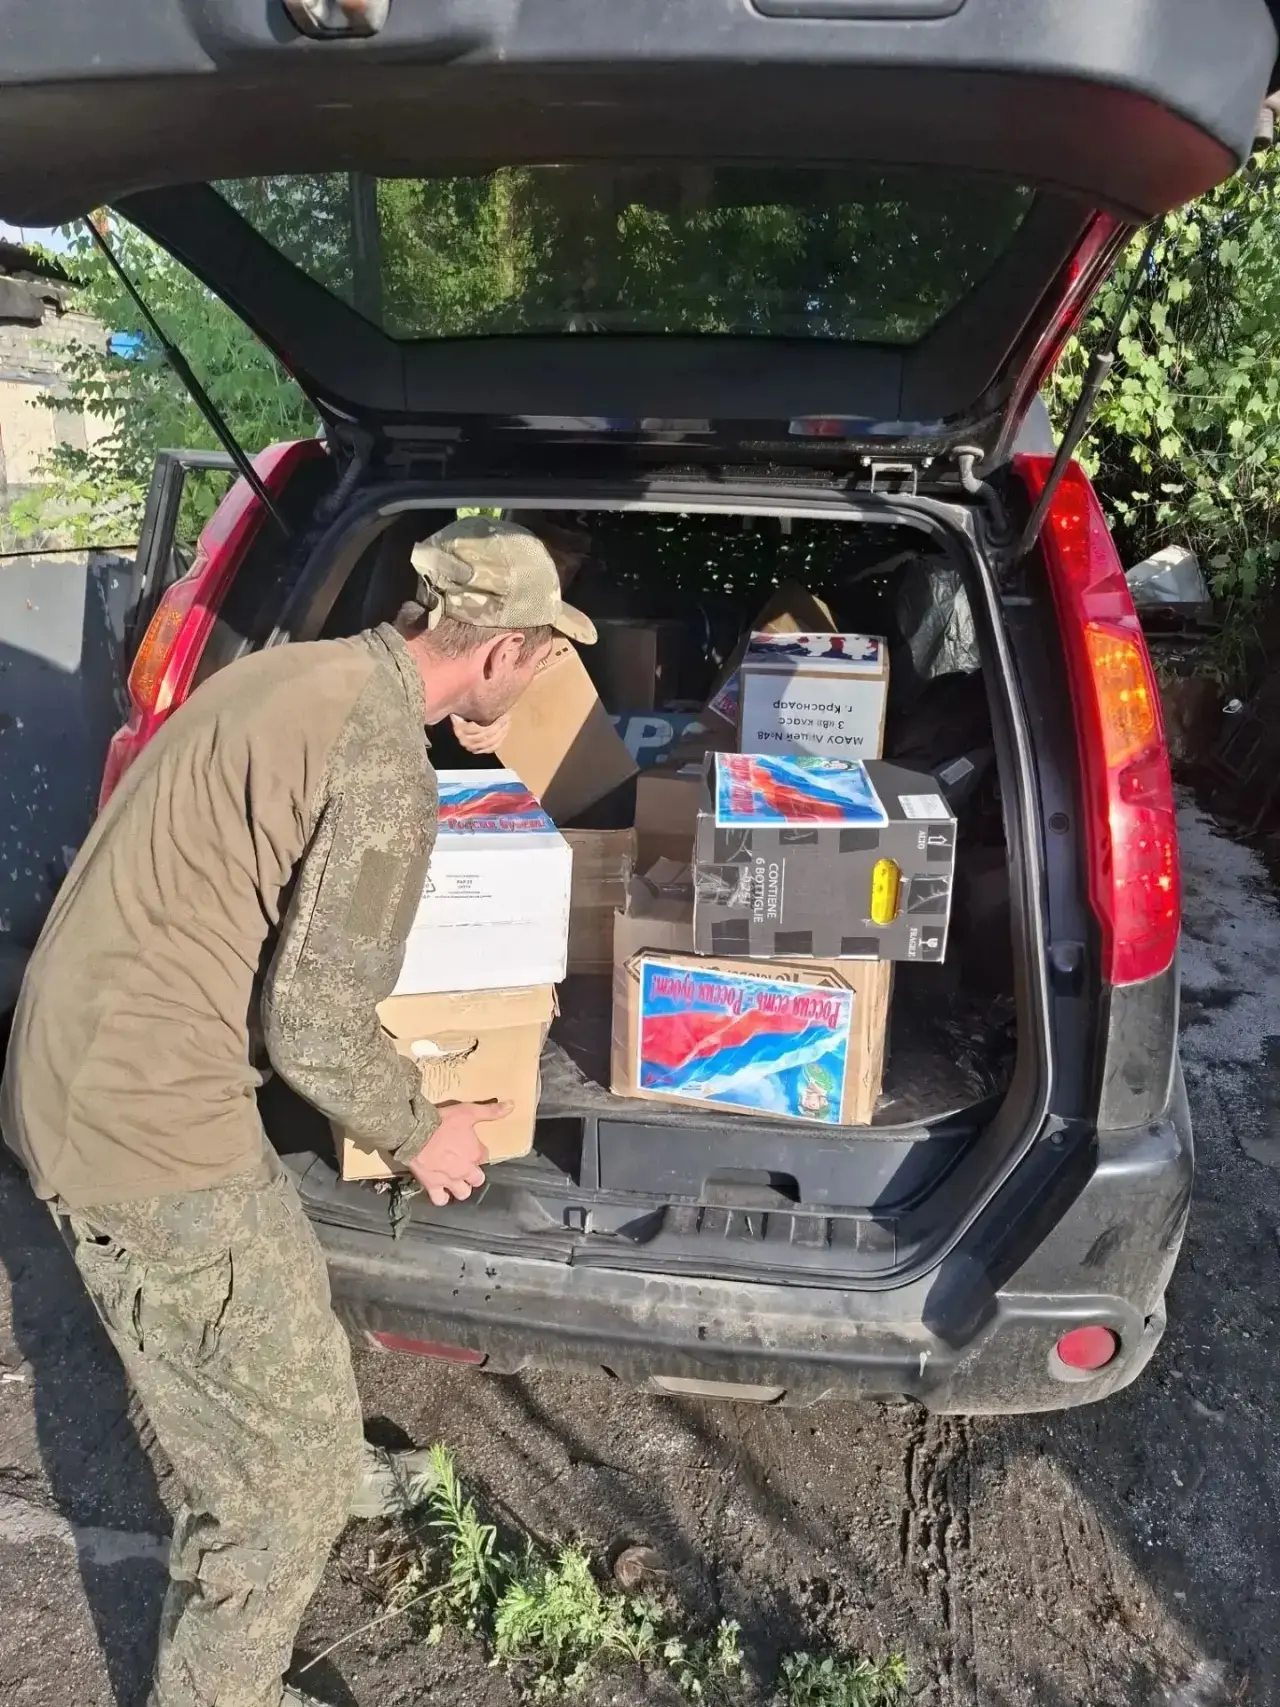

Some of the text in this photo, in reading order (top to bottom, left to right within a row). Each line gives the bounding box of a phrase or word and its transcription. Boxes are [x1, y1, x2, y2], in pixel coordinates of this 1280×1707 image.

[773, 700, 841, 714] Краснодар
[778, 717, 814, 725] класс
[827, 736, 864, 746] МАОУ
[753, 857, 765, 923] 6 BOTTIGLIE
[767, 863, 779, 919] CONTIENE
[908, 927, 918, 957] FRAGILE
[652, 973, 695, 1006] будет!
[700, 983, 744, 1016] Россия
[756, 991, 790, 1018] есть
[791, 996, 842, 1030] Россия
